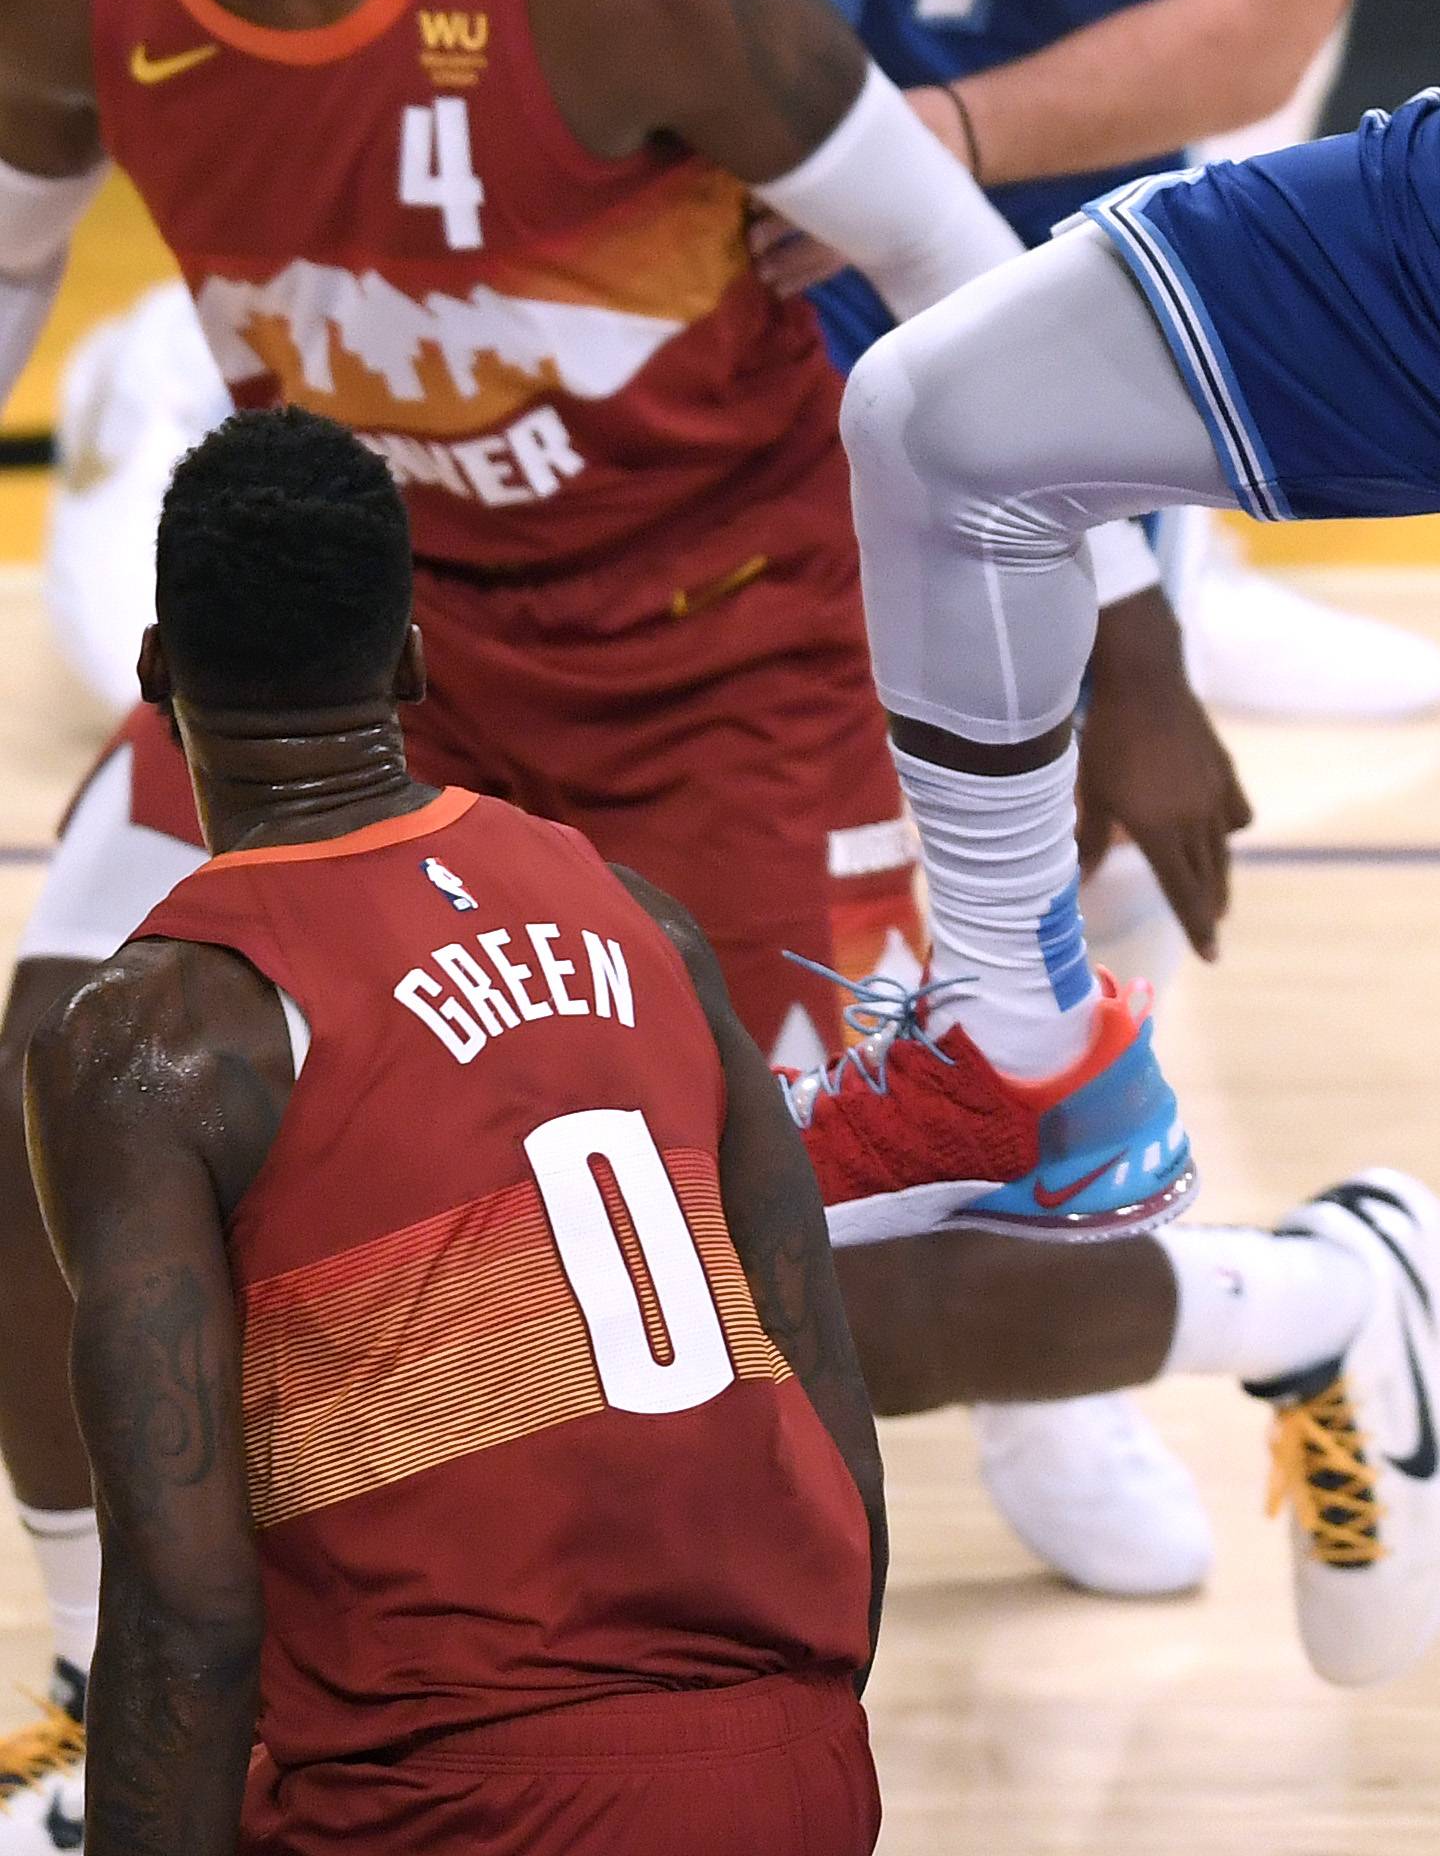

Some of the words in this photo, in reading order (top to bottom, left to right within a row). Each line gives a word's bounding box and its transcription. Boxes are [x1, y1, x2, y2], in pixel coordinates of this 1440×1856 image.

[419, 10, 488, 50] WU
[400, 96, 484, 251] 4
[394, 923, 635, 1064] GREEN
[523, 1108, 736, 1414] 0
